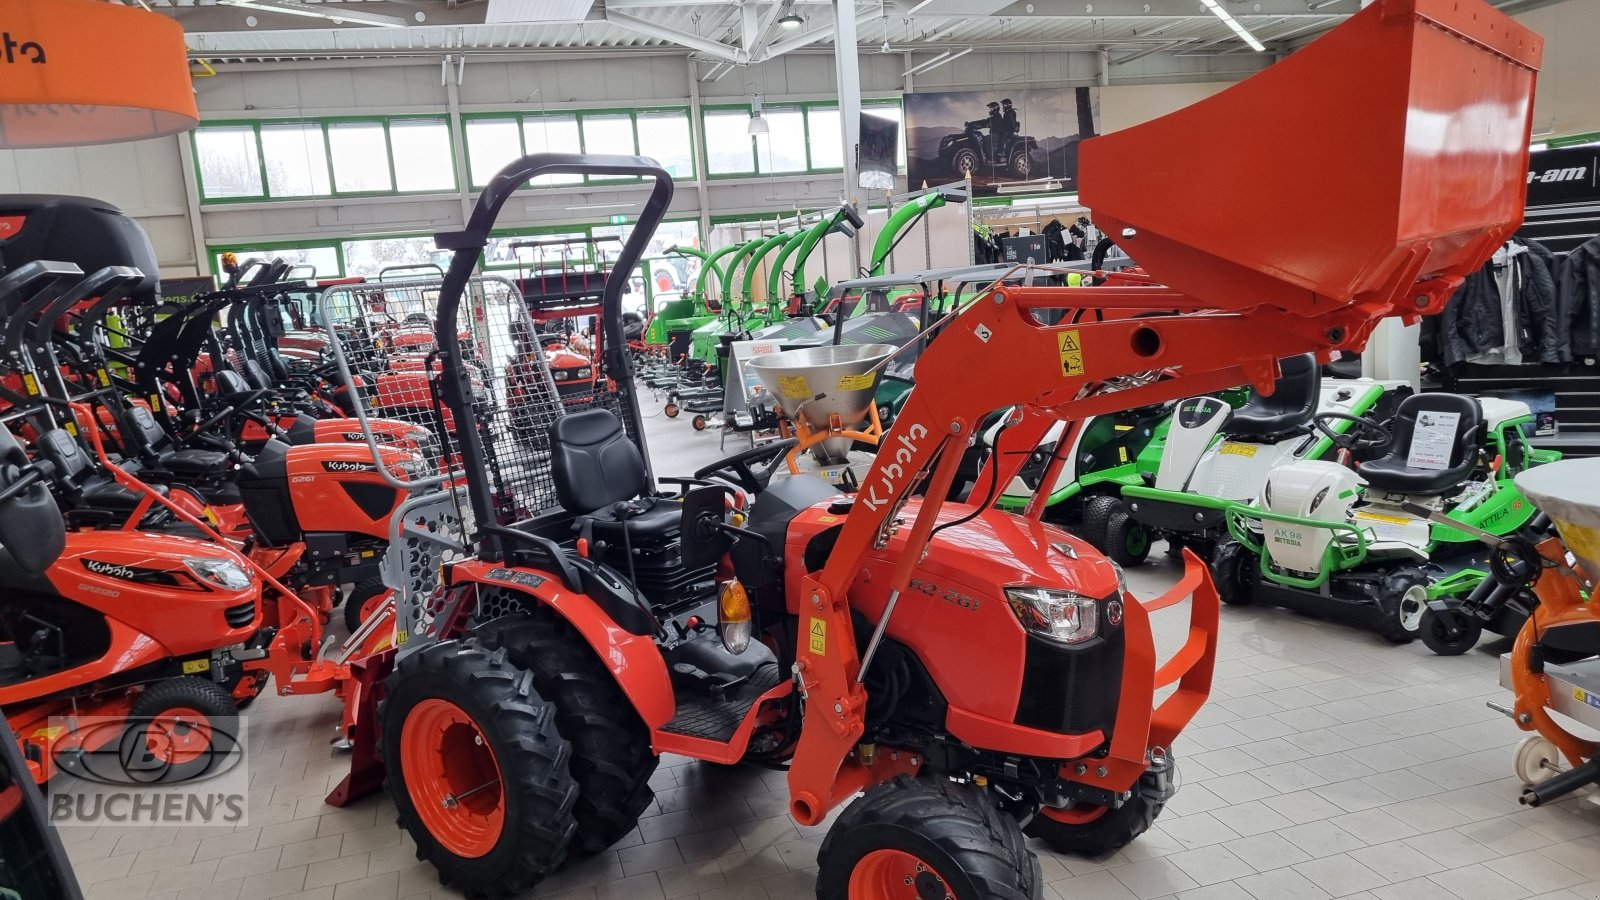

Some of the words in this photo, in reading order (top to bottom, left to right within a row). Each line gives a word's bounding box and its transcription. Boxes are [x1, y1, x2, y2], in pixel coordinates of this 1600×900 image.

[328, 461, 366, 470] Kubota
[862, 423, 928, 512] Kubota
[1479, 508, 1509, 529] ATTILA
[88, 560, 134, 578] Kubota
